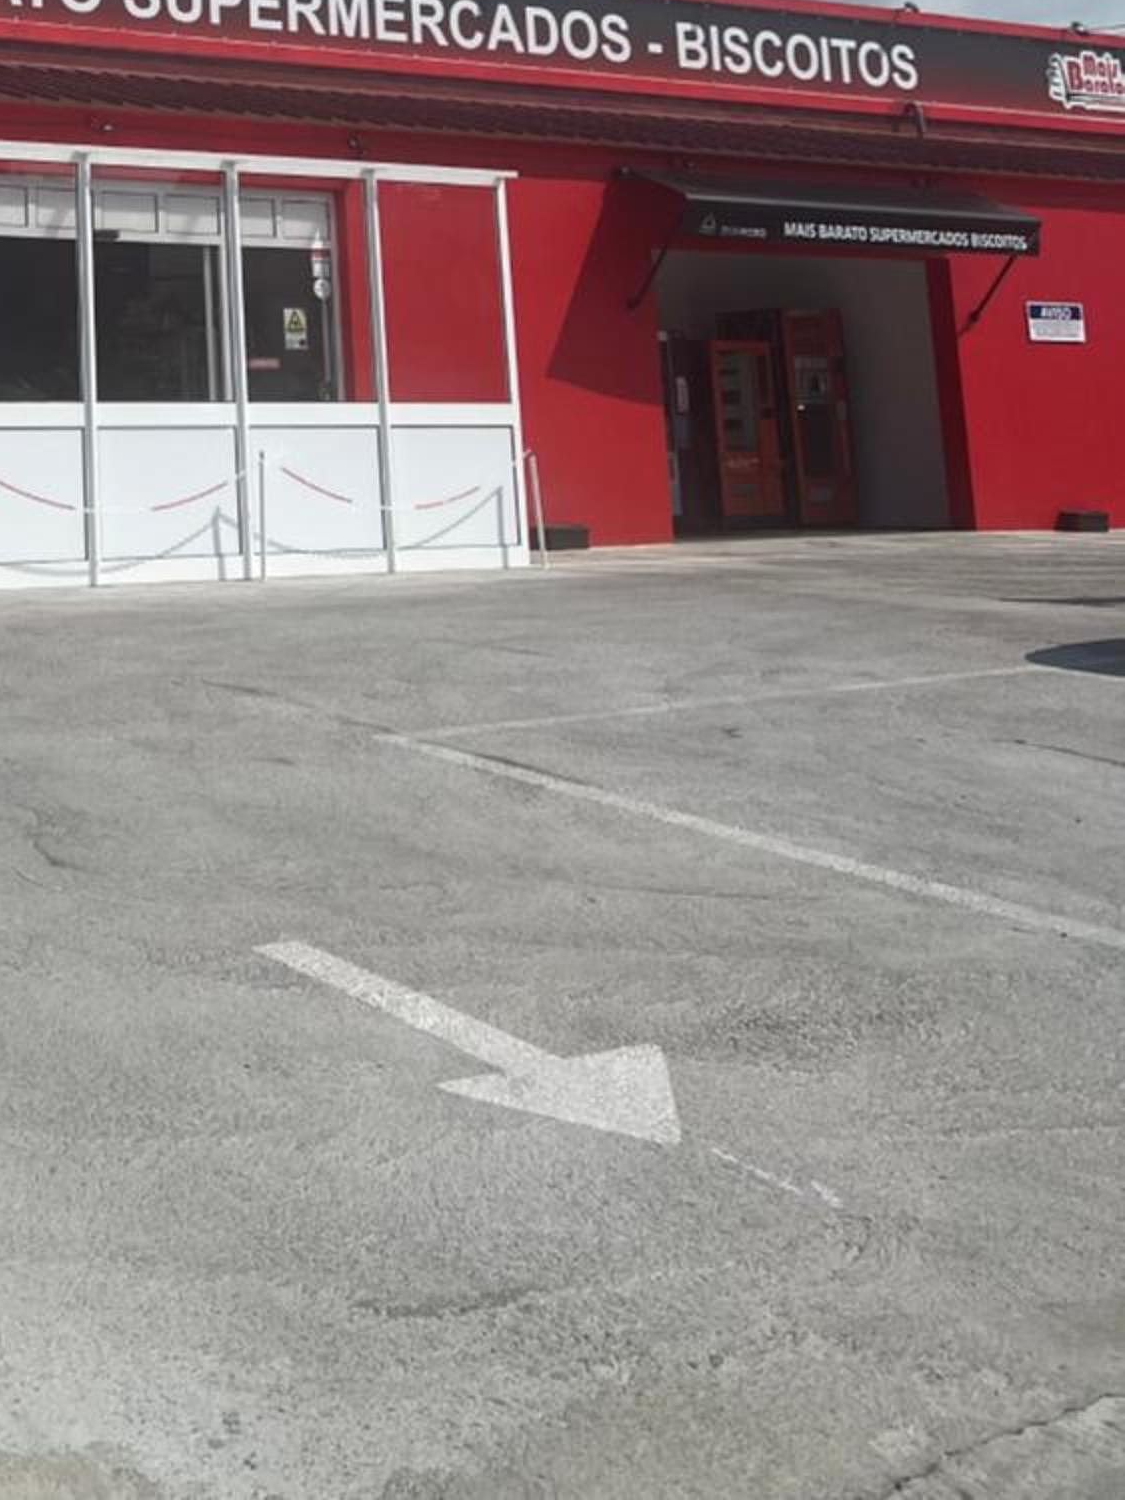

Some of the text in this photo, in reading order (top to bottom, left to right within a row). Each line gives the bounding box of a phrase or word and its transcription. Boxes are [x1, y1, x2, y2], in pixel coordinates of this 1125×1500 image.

[676, 21, 919, 90] BISCOITOS
[783, 221, 816, 239] MAIS
[818, 224, 868, 242] BARATO
[869, 227, 969, 248] SUPERMERCADOS
[970, 233, 1028, 250] BISCOITOS
